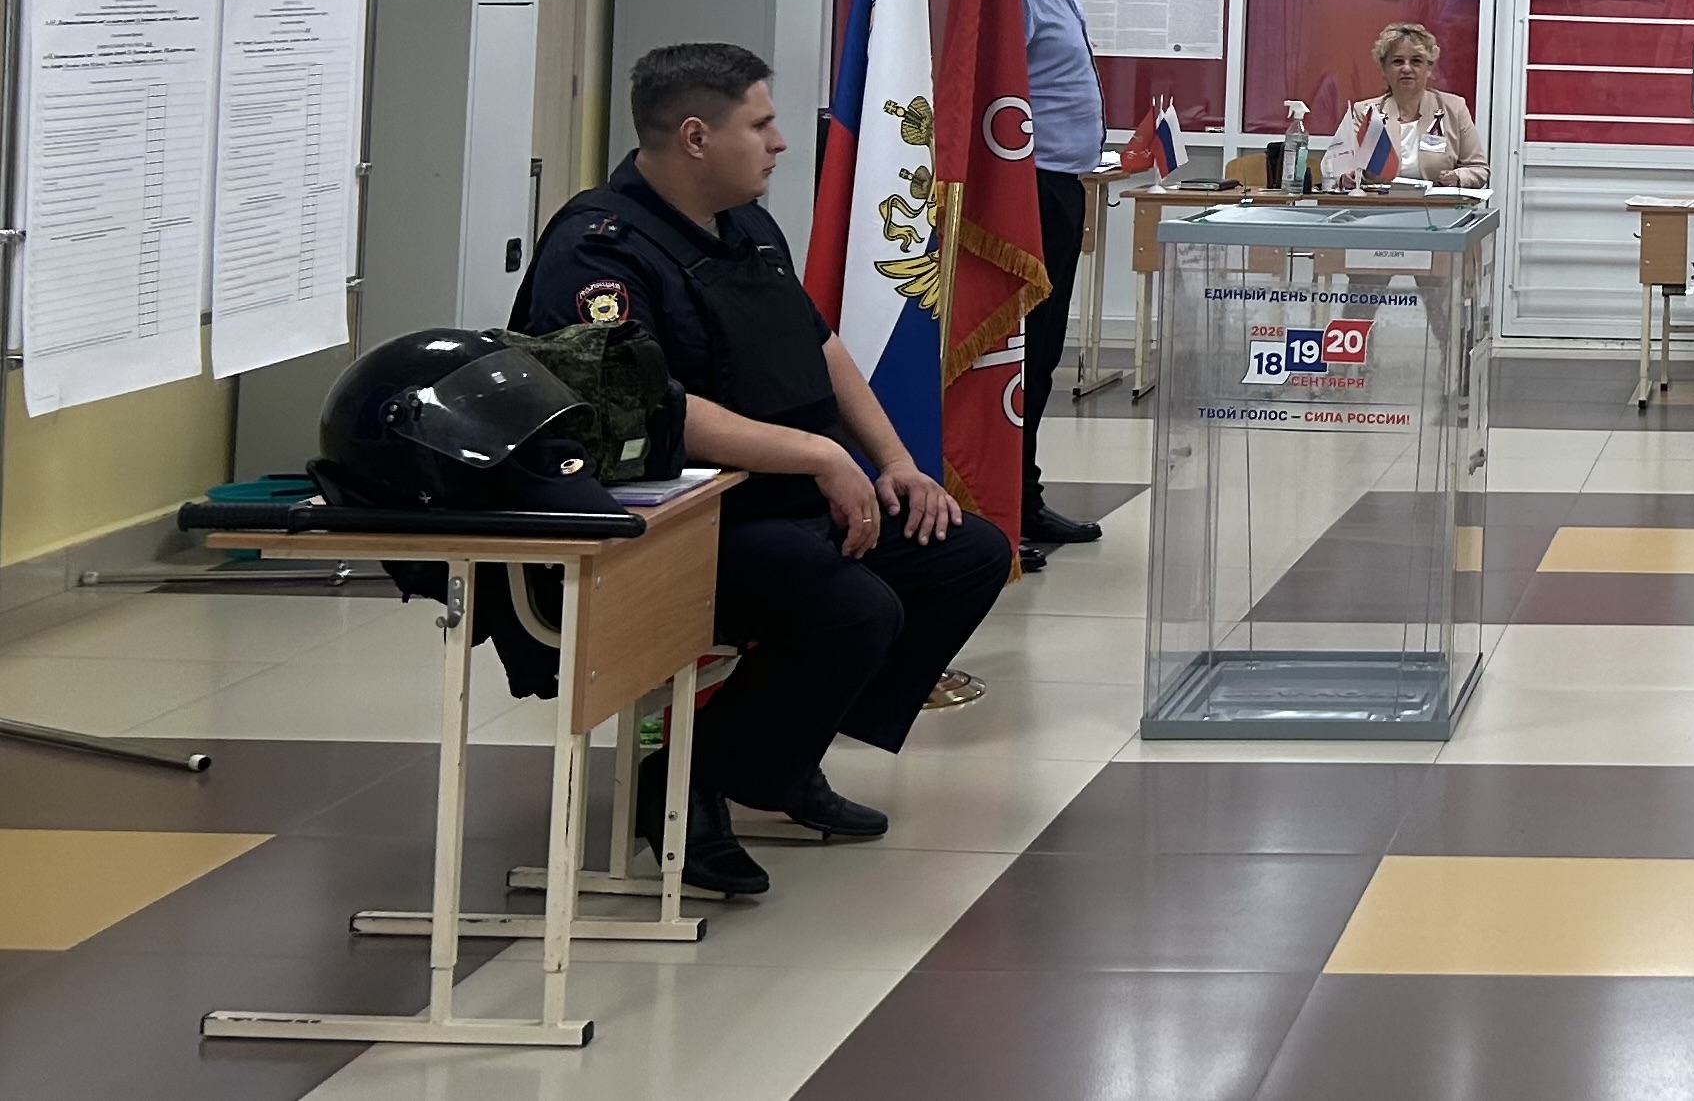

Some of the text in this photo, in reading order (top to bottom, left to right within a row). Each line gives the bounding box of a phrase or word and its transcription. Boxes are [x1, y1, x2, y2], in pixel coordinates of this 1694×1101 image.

[1204, 287, 1418, 307] ЕДИНЫЙ ДЕНЬ ГОЛОСОВАНИЯ
[1250, 325, 1285, 337] 2026
[1326, 329, 1364, 354] 20
[1289, 340, 1320, 364] 19
[1253, 351, 1283, 376] 18
[1290, 375, 1365, 388] СЕНТЯБРЯ
[1198, 406, 1236, 420] ТВОЙ
[1240, 409, 1288, 421] ГОЛОС
[1304, 411, 1344, 424] СИЛА
[1347, 412, 1411, 426] РОССИИ!
